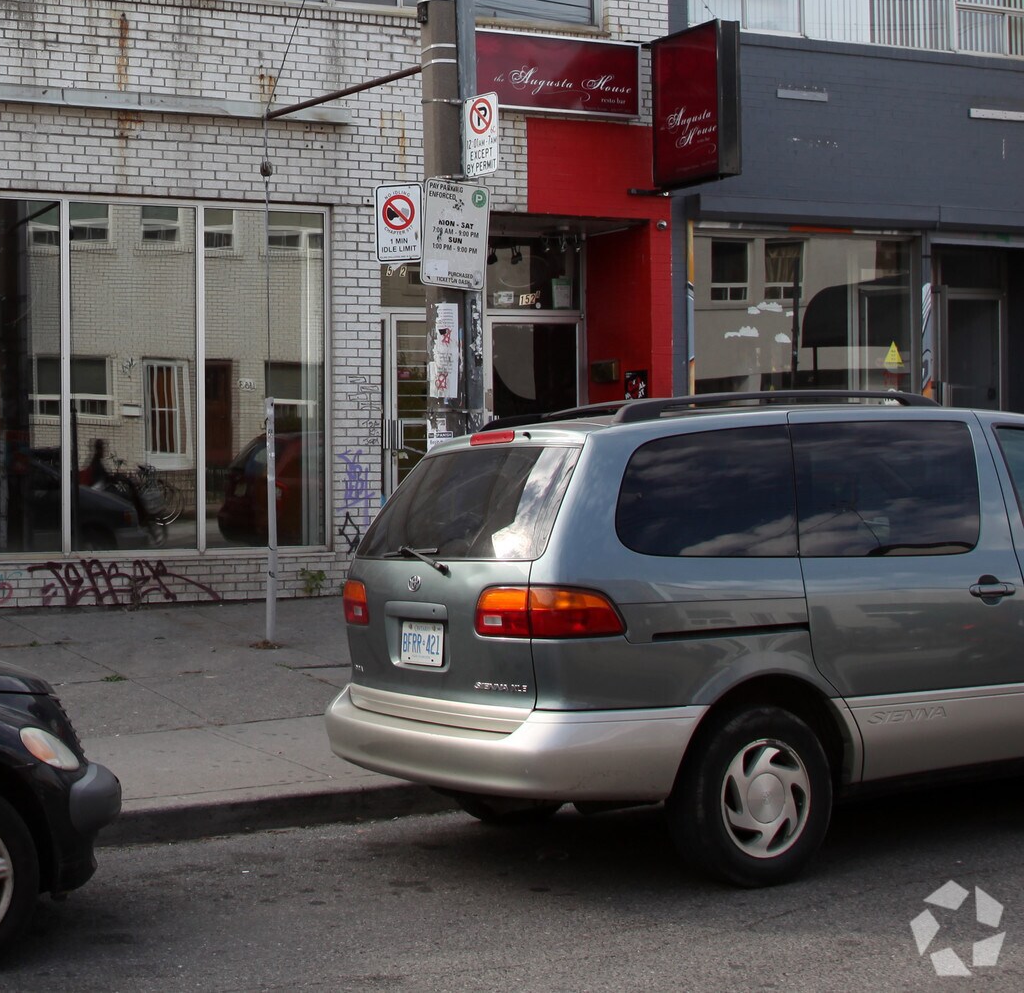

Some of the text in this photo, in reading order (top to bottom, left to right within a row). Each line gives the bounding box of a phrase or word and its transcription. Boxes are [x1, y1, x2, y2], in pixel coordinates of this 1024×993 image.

[509, 66, 573, 95] Augusta
[581, 75, 632, 94] House
[667, 107, 711, 135] Augusta
[676, 125, 717, 148] House
[470, 147, 493, 161] EXCEPT
[466, 158, 496, 174] BY PERMIT
[429, 182, 440, 190] PAY
[429, 190, 456, 201] ENFORCED
[438, 219, 455, 227] MON
[460, 221, 474, 229] SAT
[443, 227, 454, 235] AM
[395, 237, 408, 245] MIN
[448, 236, 463, 245] SUN
[381, 244, 417, 254] IDLE LIMIT
[442, 243, 452, 251] PM
[468, 246, 478, 254] PM
[403, 632, 440, 655] BFRR 421
[867, 705, 947, 725] SIENNA
